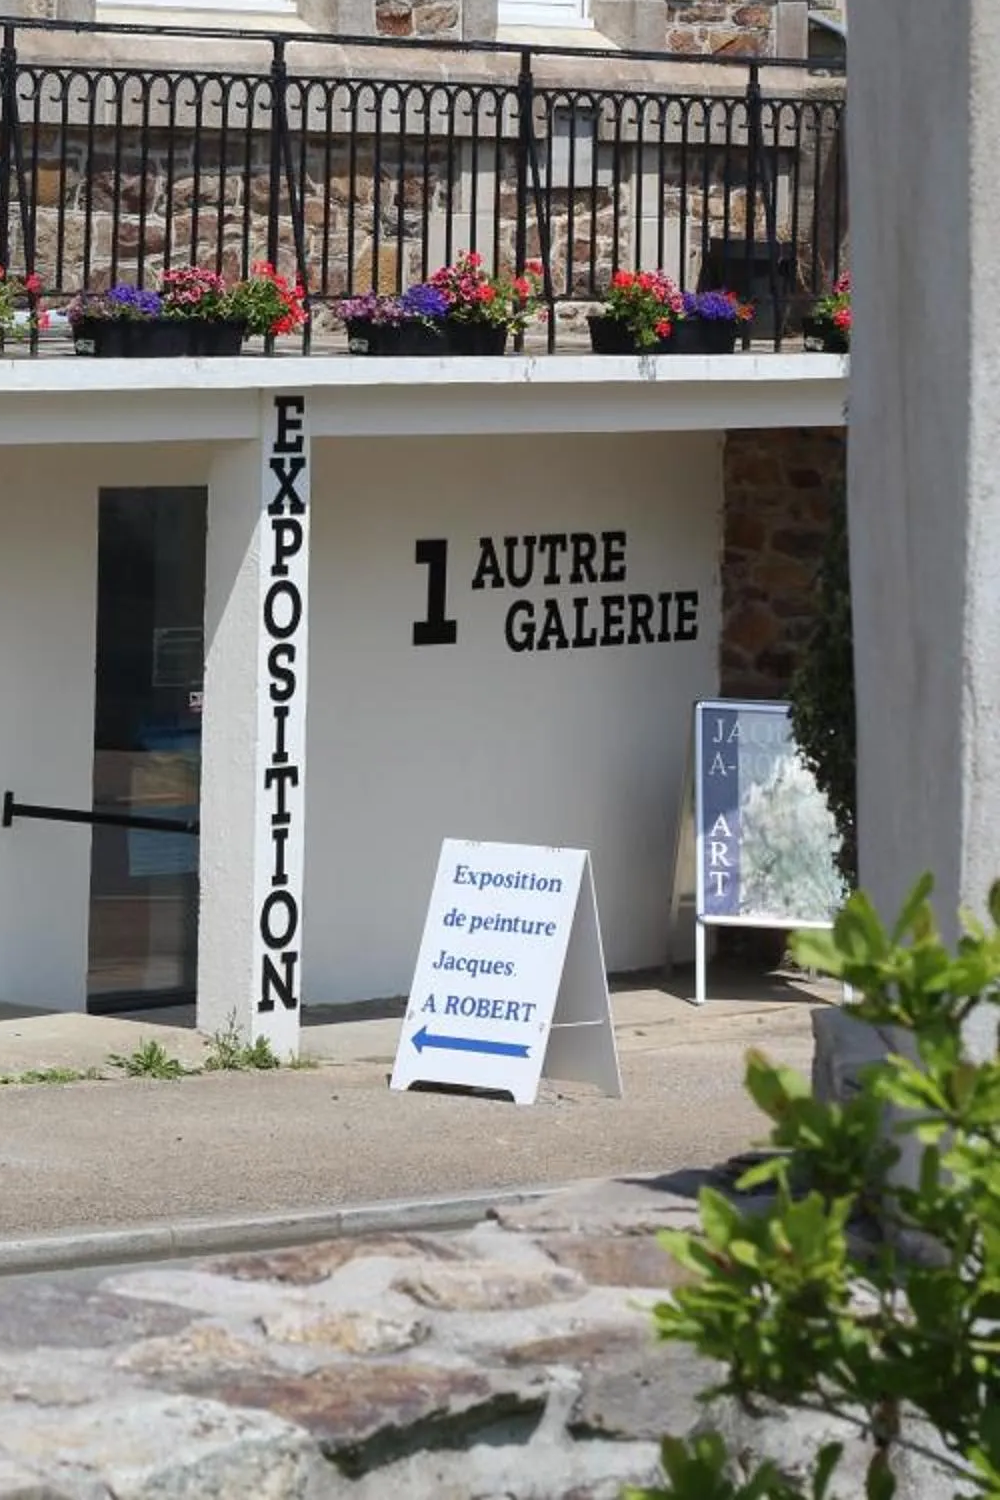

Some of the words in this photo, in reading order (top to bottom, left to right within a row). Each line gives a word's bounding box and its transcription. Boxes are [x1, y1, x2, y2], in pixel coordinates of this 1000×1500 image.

[412, 539, 458, 647] 1
[471, 531, 628, 590] AUTRE
[504, 590, 700, 653] GALERIE
[257, 395, 306, 1014] EXPOSITION
[452, 864, 563, 894] Exposition
[709, 813, 733, 898] ART
[442, 907, 465, 928] de
[468, 912, 557, 937] peinture
[432, 950, 515, 978] Jacques
[420, 993, 437, 1014] A
[443, 994, 537, 1024] ROBERT
